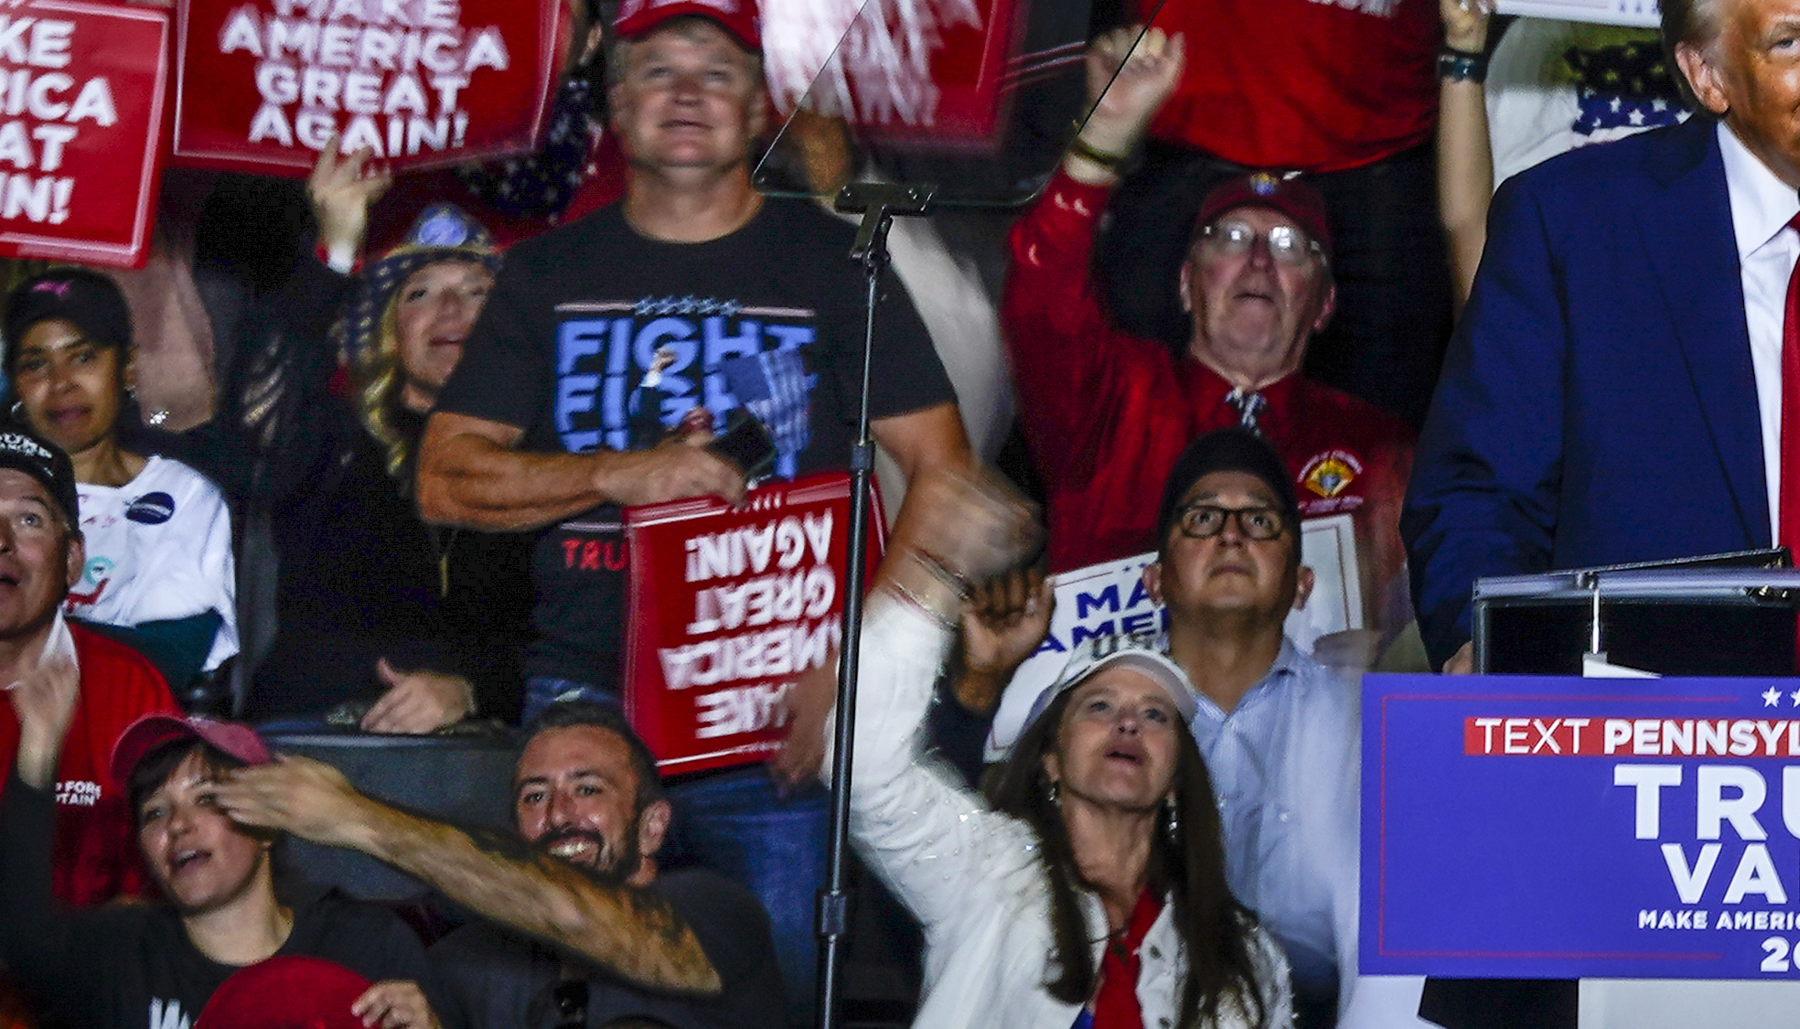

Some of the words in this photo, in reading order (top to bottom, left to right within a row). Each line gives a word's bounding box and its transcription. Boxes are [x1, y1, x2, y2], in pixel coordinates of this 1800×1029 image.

[0, 14, 76, 68] KE
[219, 4, 509, 72] AMERICA
[256, 62, 471, 117] GREAT
[248, 104, 469, 158] AGAIN!
[557, 316, 817, 377] FIGHT
[562, 539, 629, 570] TRU
[685, 507, 833, 583] AGAIN!
[686, 563, 836, 635] GREAT
[1076, 577, 1150, 620] MA
[1475, 718, 1590, 754] TEXT
[1638, 910, 1708, 930] MAKE
